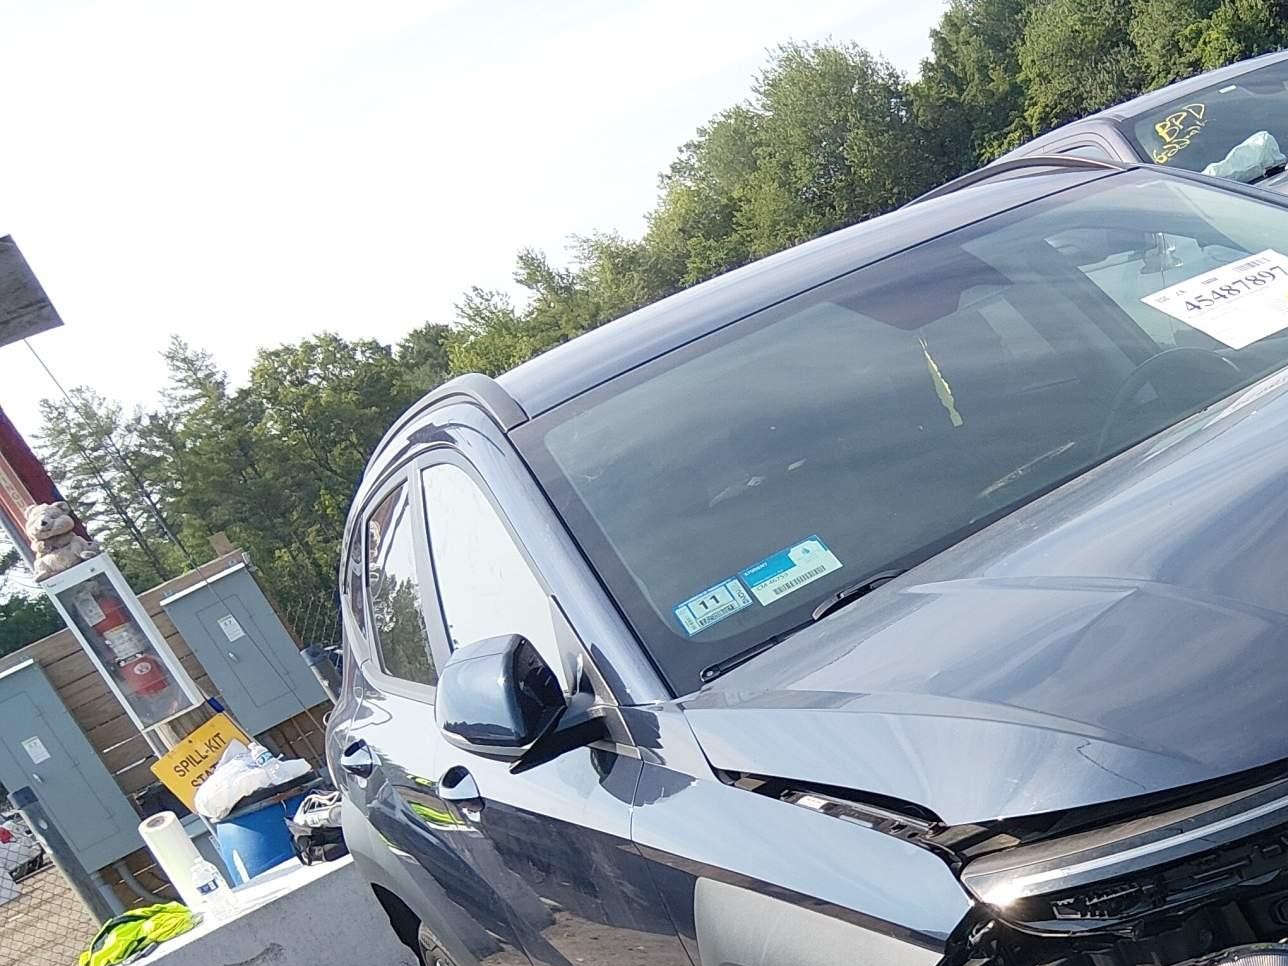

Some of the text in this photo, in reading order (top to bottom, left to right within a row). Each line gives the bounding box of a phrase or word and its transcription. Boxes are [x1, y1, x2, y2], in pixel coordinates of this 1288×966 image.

[1185, 265, 1288, 313] 45487897
[698, 595, 720, 610] 11
[173, 732, 226, 777] SPILL-KIT
